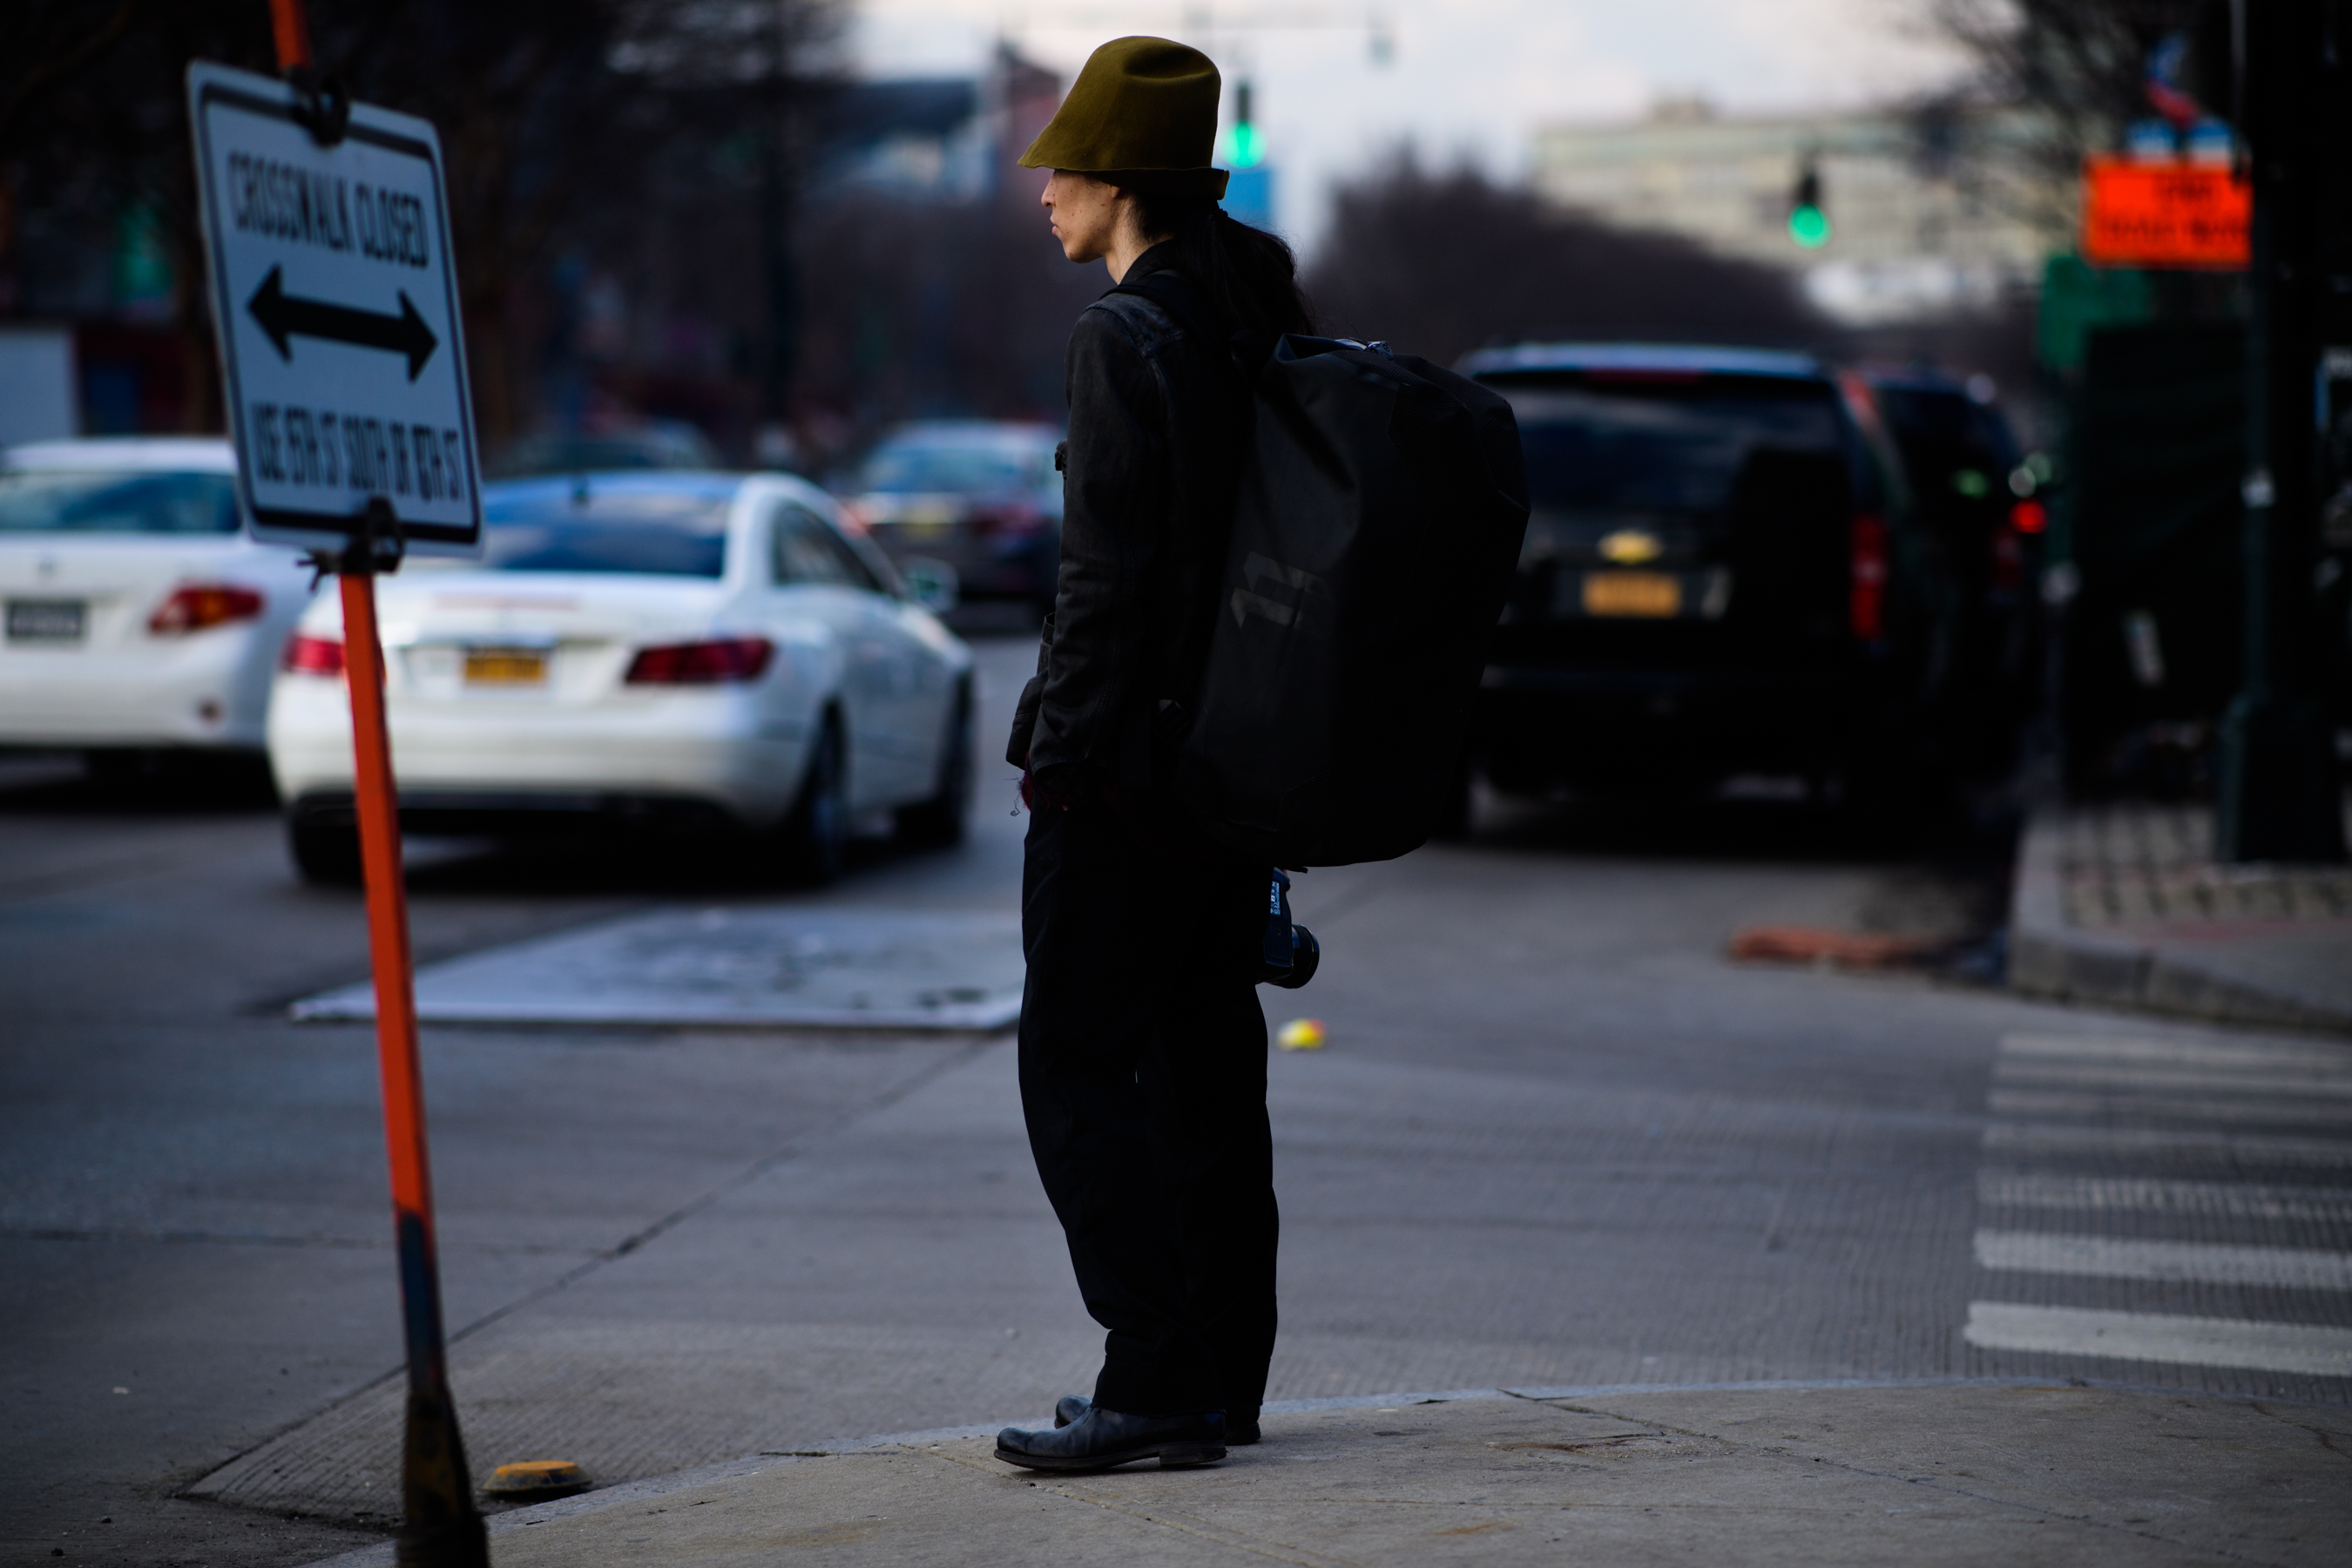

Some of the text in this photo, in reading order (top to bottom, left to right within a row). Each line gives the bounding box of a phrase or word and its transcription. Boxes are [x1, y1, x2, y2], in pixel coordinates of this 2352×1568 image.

[227, 150, 429, 270] CROSSWALK CLOSED
[253, 402, 286, 483] USE
[320, 411, 341, 488] ST
[342, 415, 390, 493] SOUTH
[389, 419, 413, 496] OF
